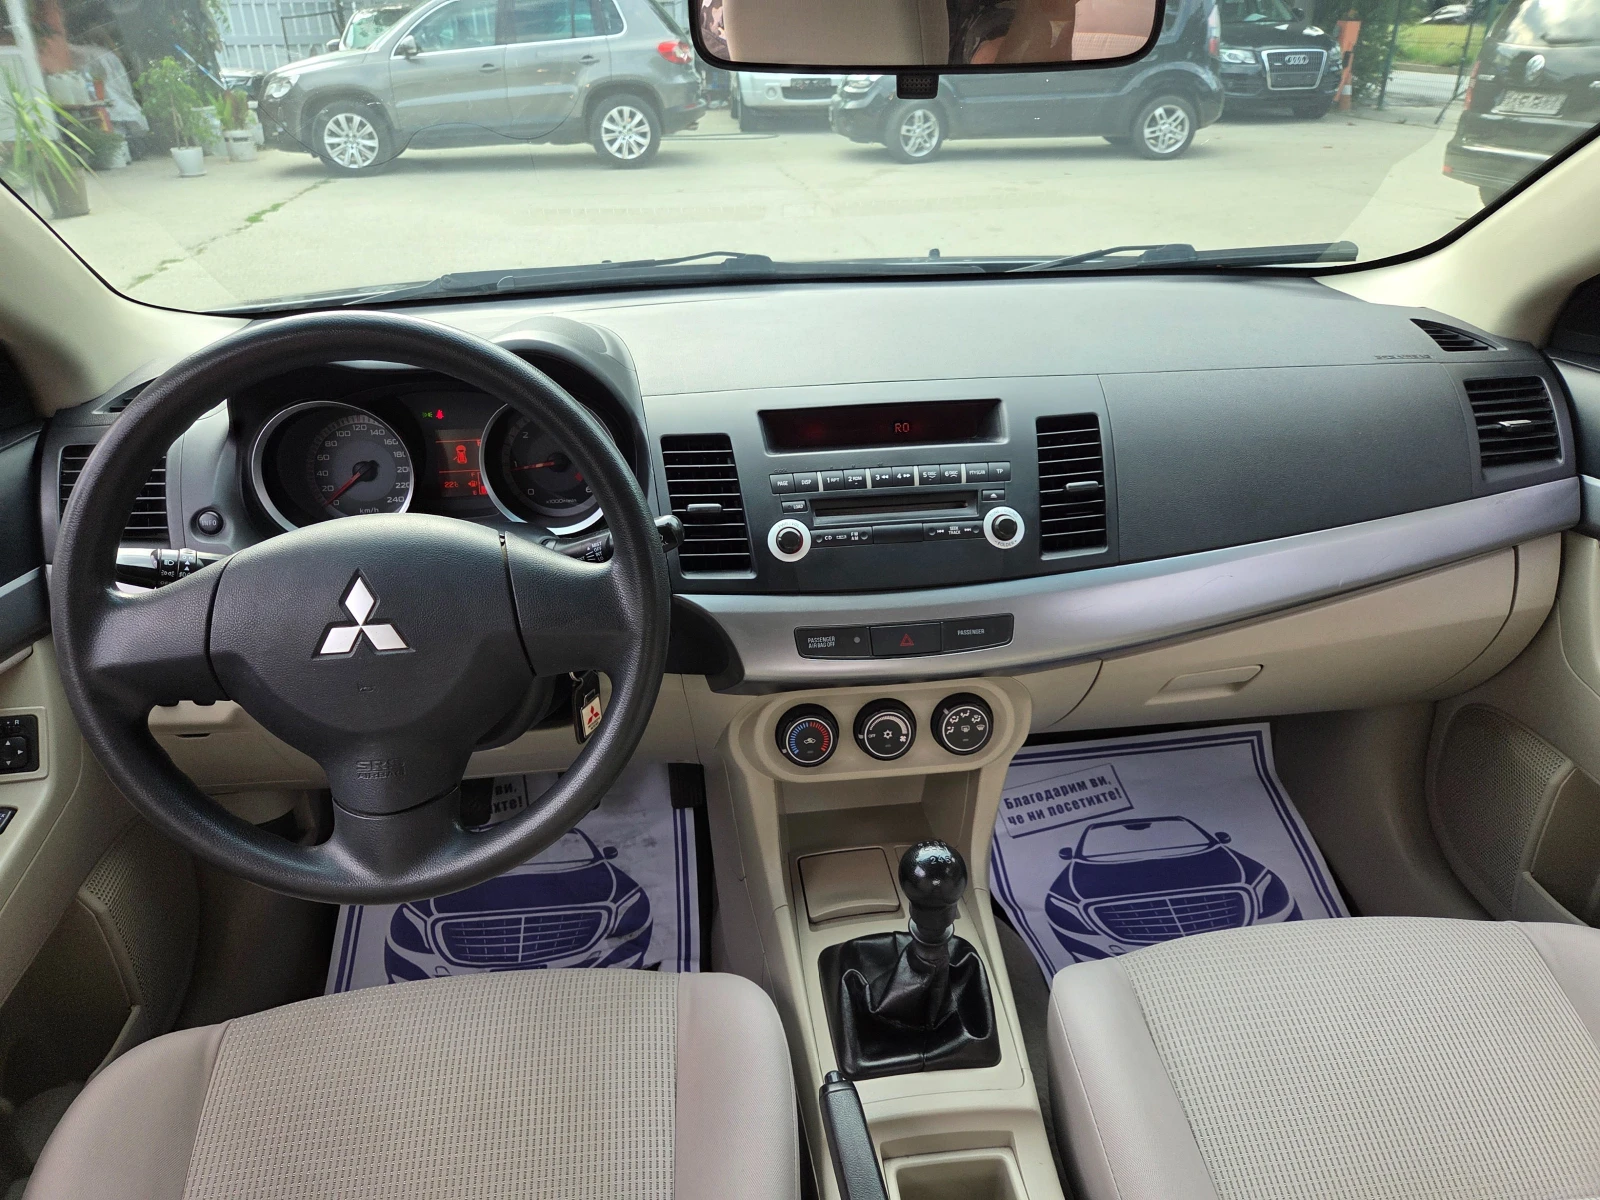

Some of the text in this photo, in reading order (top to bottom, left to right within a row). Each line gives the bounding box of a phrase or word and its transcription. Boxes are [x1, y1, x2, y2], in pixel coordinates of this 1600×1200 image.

[522, 431, 529, 439] 2
[801, 478, 812, 486] DISP
[527, 488, 535, 496] 0
[957, 628, 985, 636] PASSENGER
[807, 635, 836, 644] PASSENGER
[1003, 780, 1088, 810] Благодарим
[1007, 787, 1123, 826] че ни посетихте!
[930, 856, 937, 865] 2
[937, 855, 945, 863] 4
